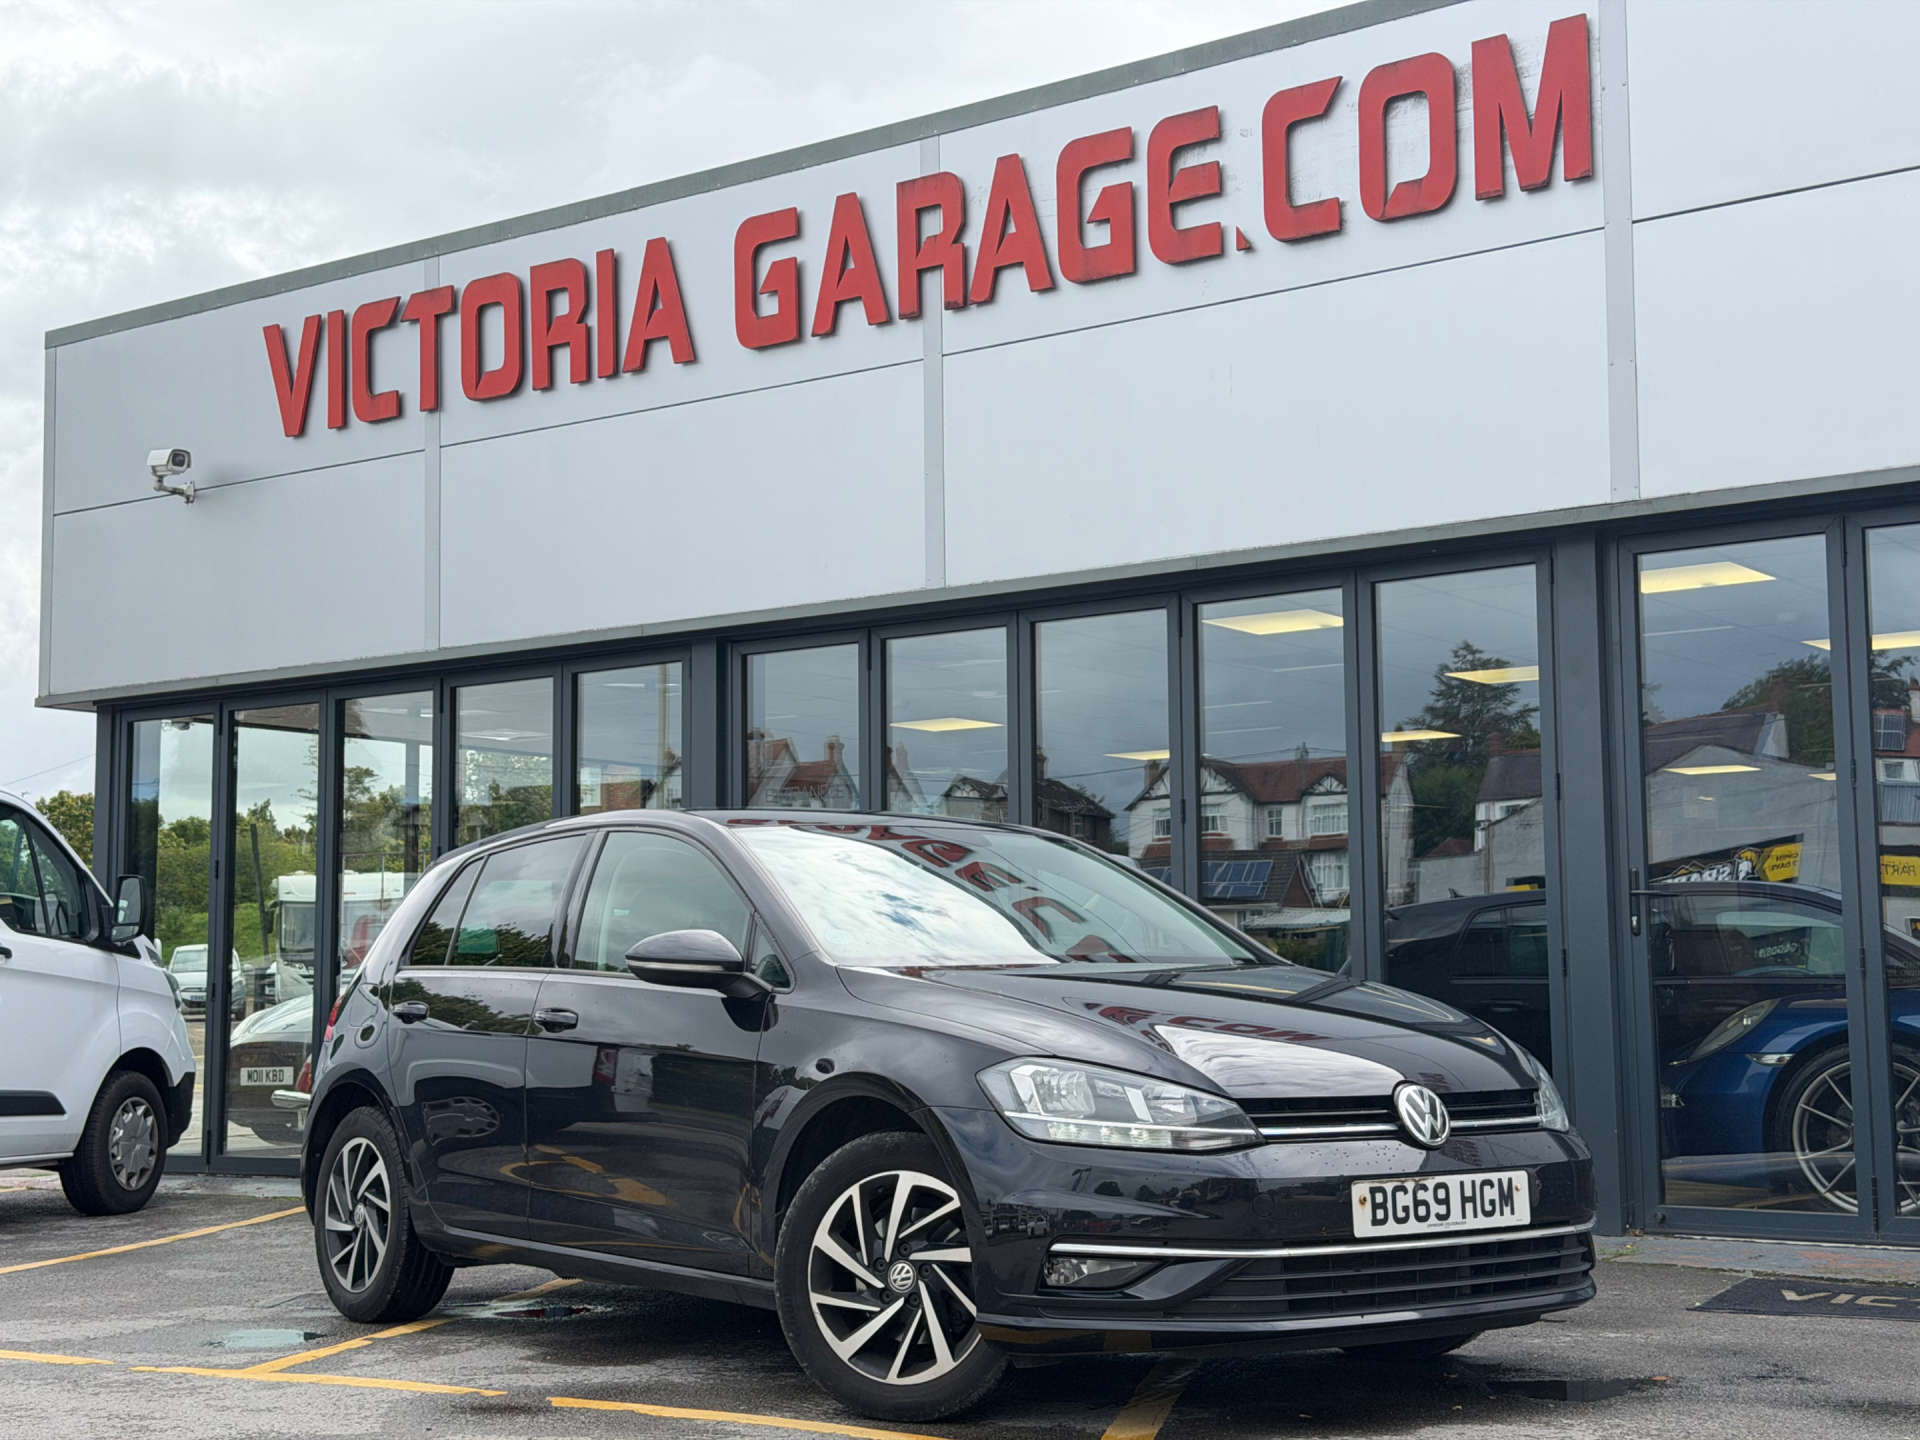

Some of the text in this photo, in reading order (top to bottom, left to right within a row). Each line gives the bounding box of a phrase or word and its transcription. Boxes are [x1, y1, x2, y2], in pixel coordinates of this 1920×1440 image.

[262, 12, 1593, 438] VICTORIA GARAGE.COM
[1369, 1177, 1515, 1227] BG69 HGM
[1780, 1288, 1920, 1308] VIC
